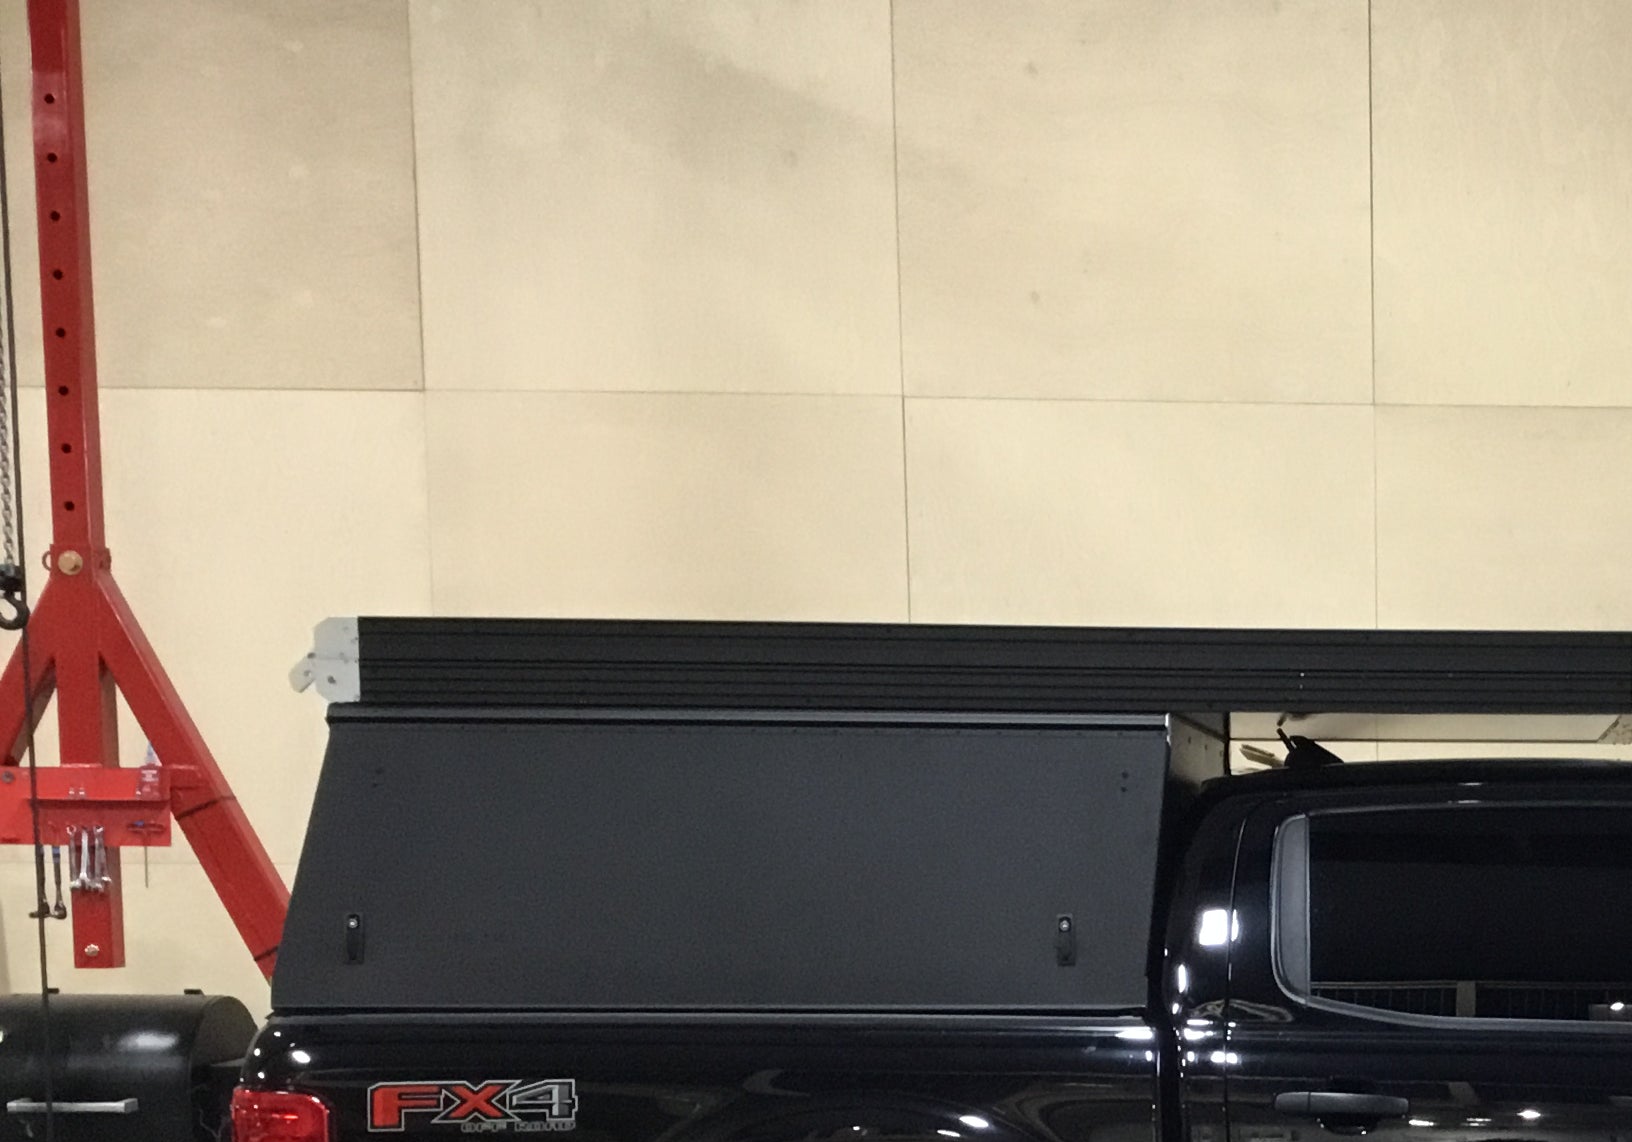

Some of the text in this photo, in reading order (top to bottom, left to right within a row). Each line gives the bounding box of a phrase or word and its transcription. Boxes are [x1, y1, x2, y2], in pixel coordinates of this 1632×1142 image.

[367, 1079, 578, 1132] FX4
[461, 1120, 576, 1133] OFF ROAD
